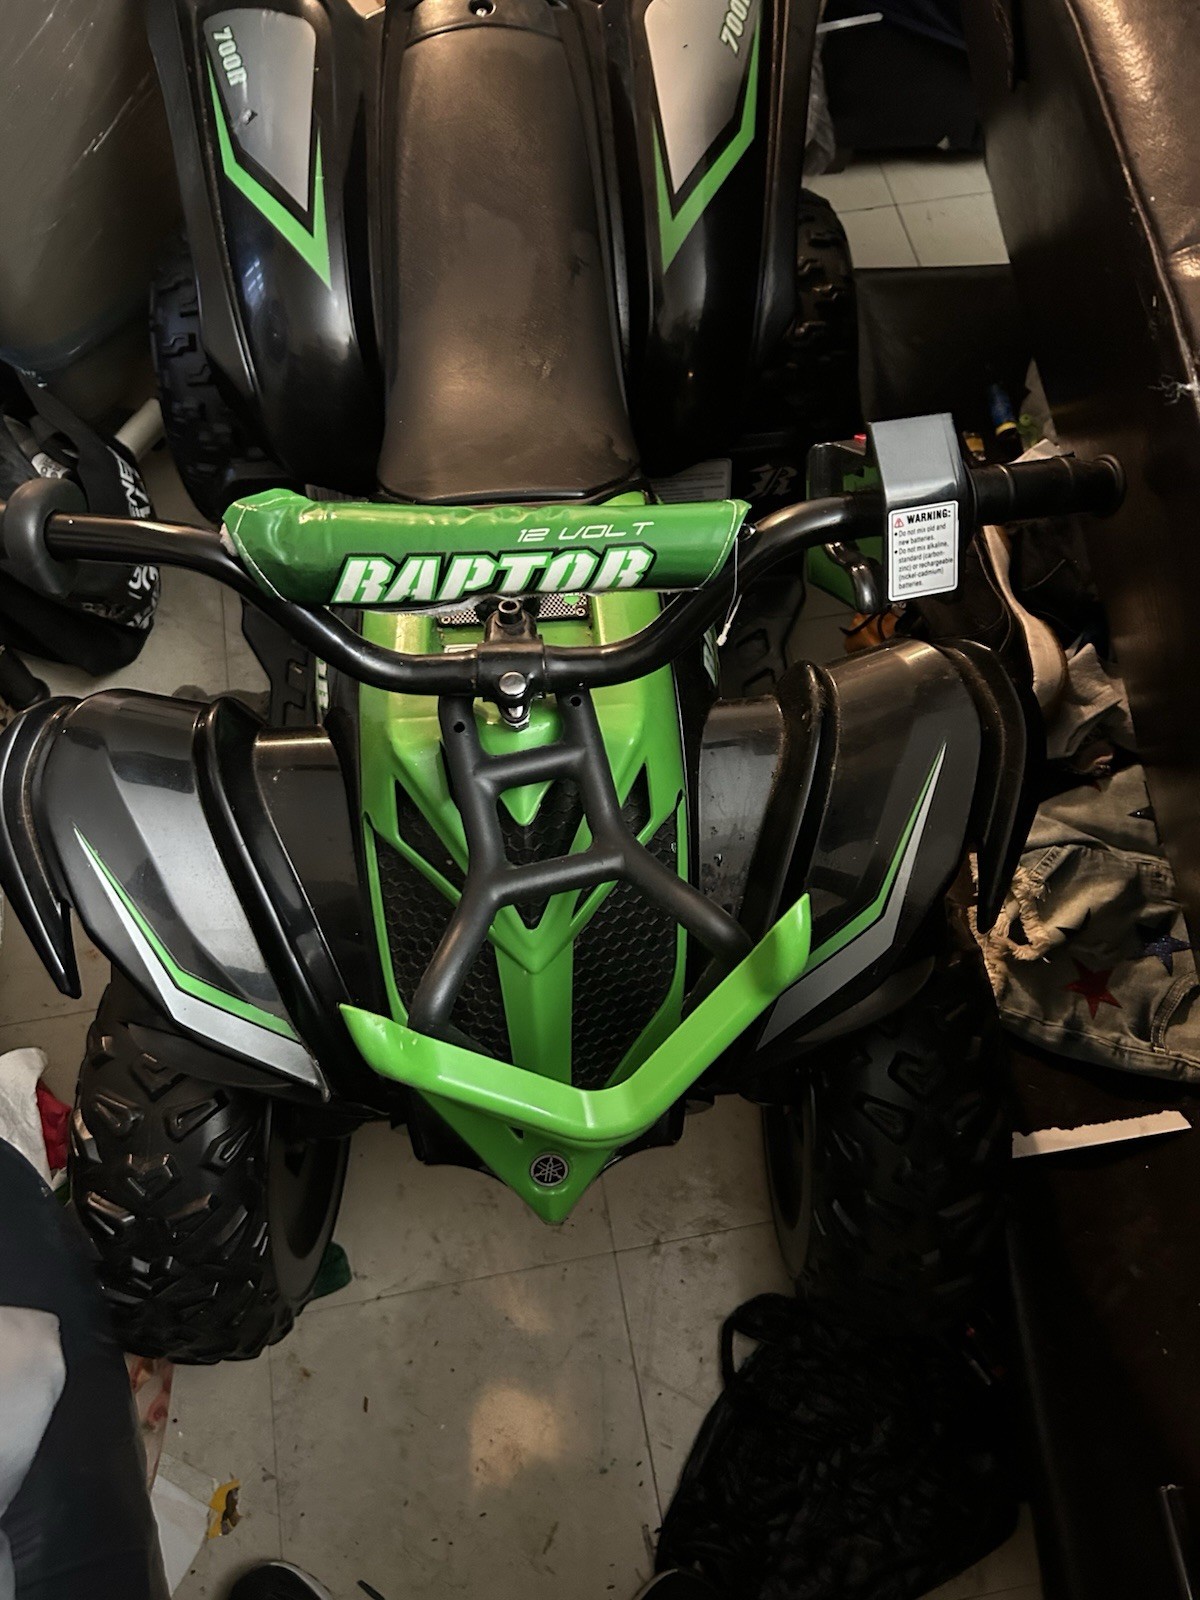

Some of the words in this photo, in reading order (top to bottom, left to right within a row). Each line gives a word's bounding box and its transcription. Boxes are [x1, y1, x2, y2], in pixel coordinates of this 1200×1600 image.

[213, 25, 248, 87] 700R
[906, 508, 951, 524] WARNING:
[517, 528, 550, 543] 12
[558, 521, 655, 541] VOLT
[898, 530, 906, 538] Do
[907, 528, 916, 536] not
[916, 527, 926, 535] mix
[927, 525, 936, 533] old
[936, 523, 947, 531] and
[898, 548, 906, 556] Do
[907, 546, 916, 554] not
[916, 544, 926, 552] mix
[898, 554, 922, 564] standard
[919, 557, 954, 568] rechargeable
[330, 543, 656, 603] RAPTOR
